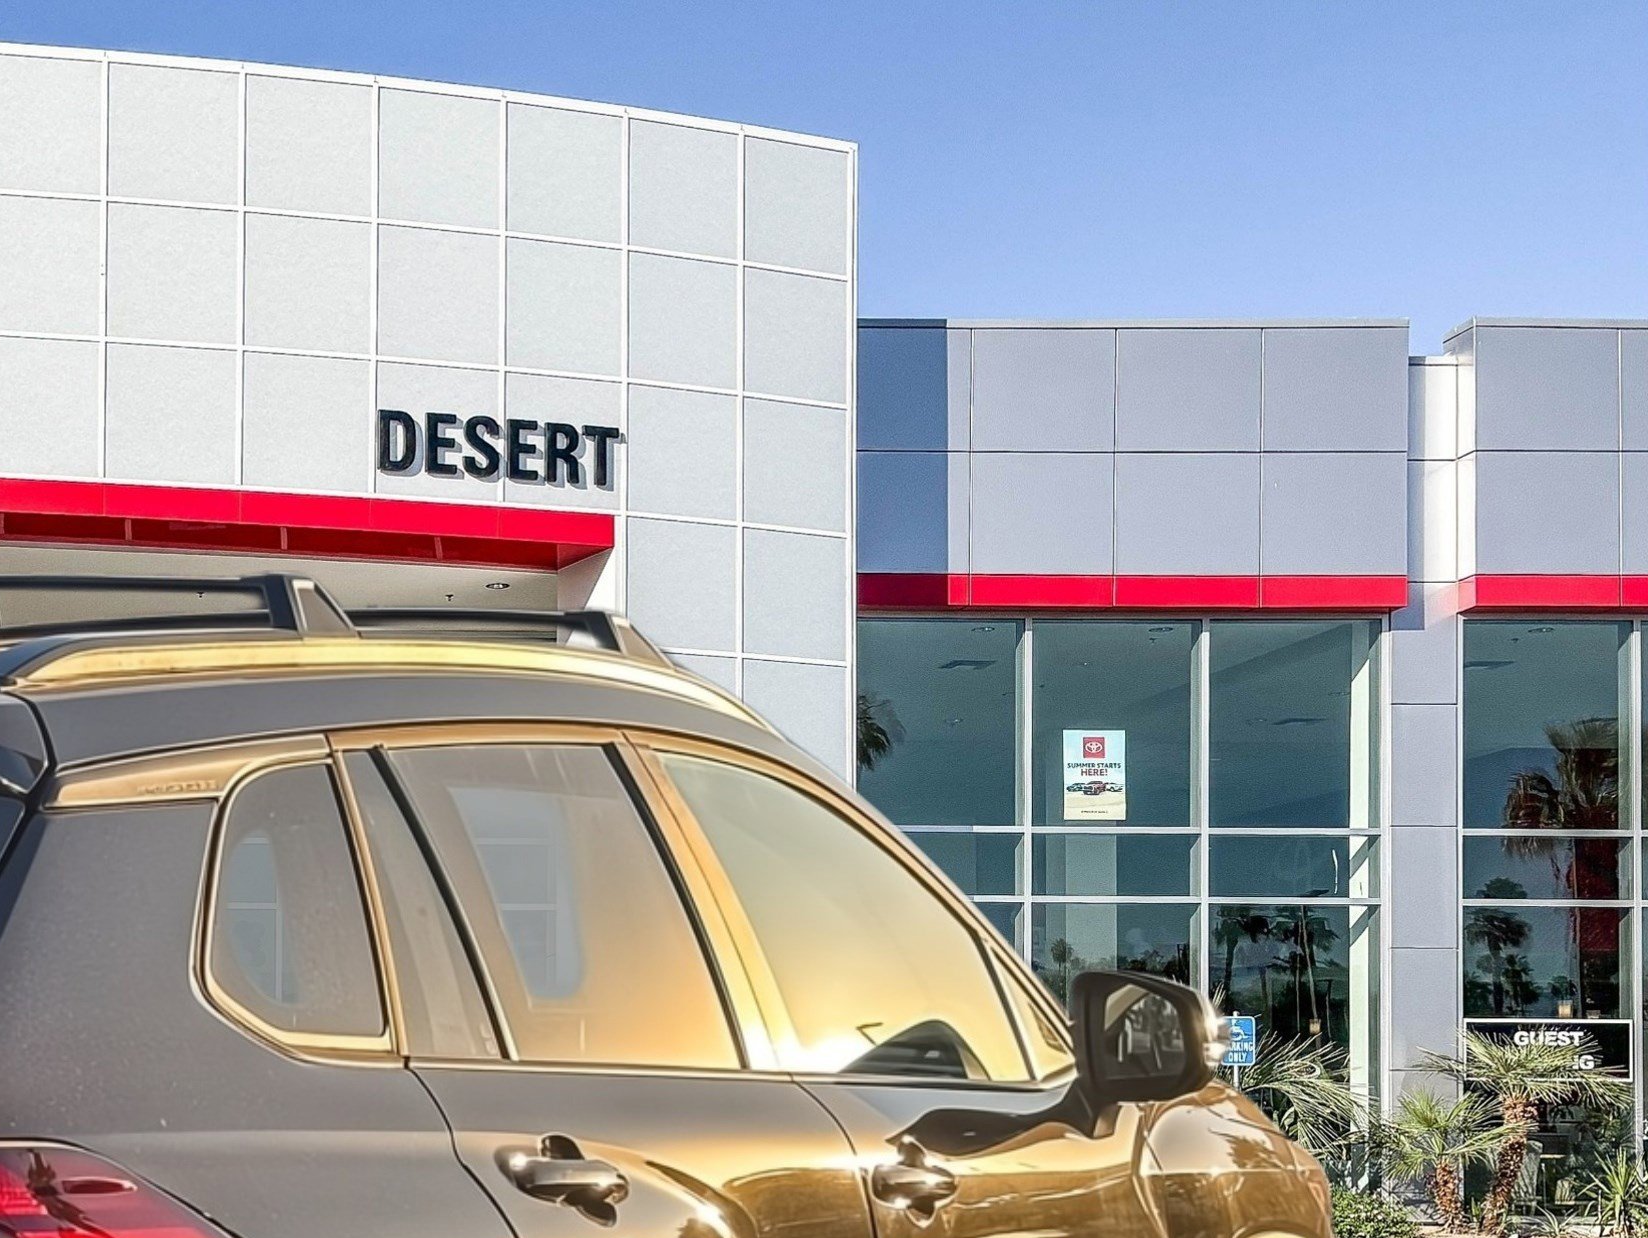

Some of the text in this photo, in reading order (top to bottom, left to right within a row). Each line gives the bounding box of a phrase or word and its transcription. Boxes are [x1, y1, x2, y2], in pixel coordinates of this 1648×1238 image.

[378, 409, 620, 486] DESERT
[1513, 1031, 1584, 1047] GUEST
[1228, 1052, 1247, 1062] ONLY
